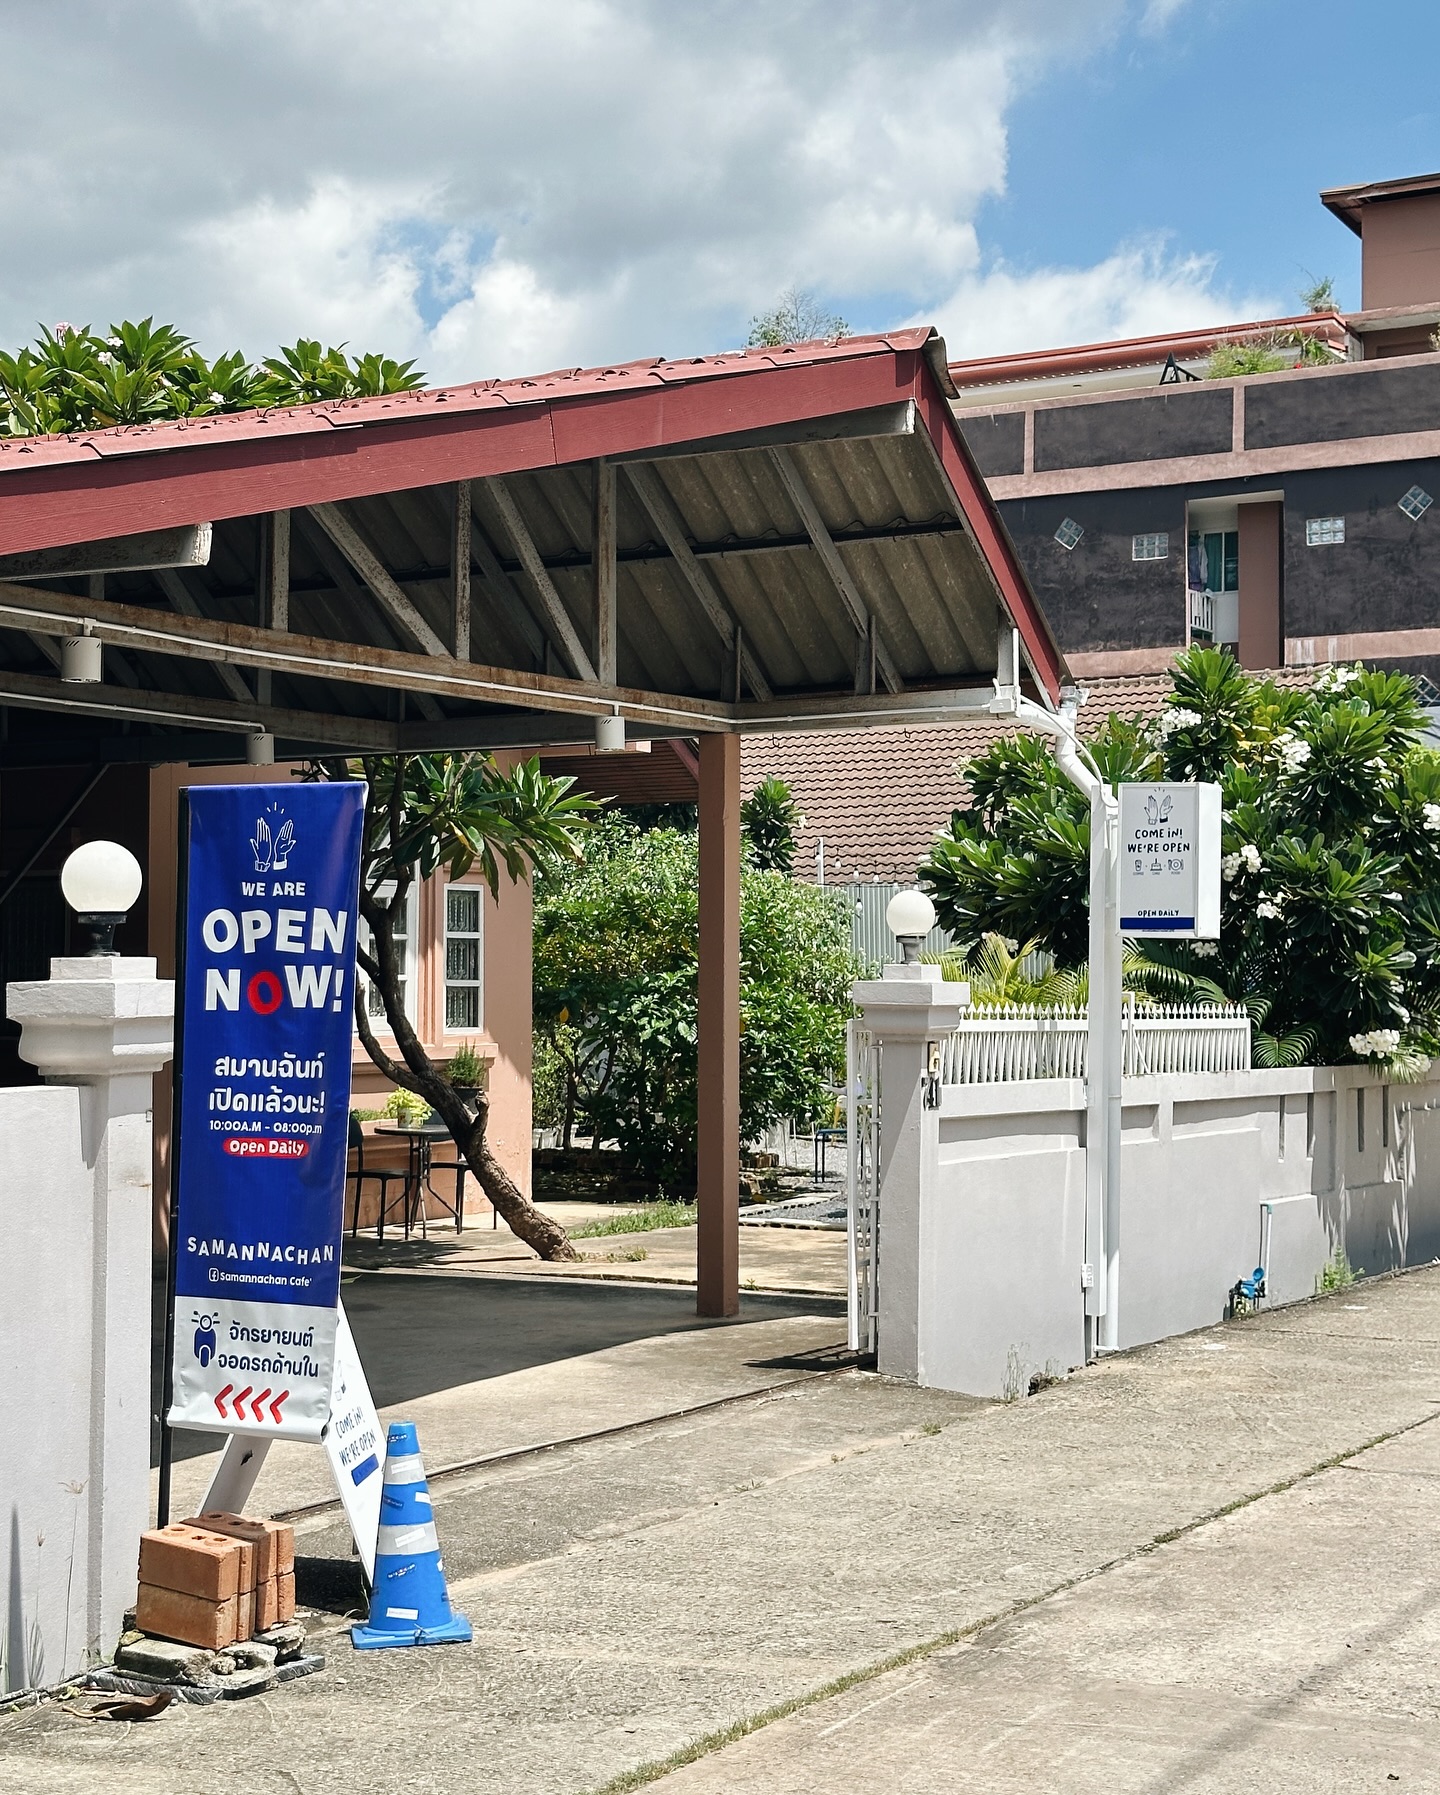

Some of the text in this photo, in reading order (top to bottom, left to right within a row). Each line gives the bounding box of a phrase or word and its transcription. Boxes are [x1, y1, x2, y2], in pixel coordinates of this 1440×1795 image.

[1134, 829, 1164, 839] COME
[1127, 842, 1190, 854] WE'RE OPEN
[241, 881, 306, 897] WE ARE
[1137, 910, 1157, 918] OPEN
[202, 907, 348, 954] OPEN
[205, 965, 345, 1016] NOW!
[214, 1051, 326, 1079] สมานฉันท์
[209, 1085, 326, 1114] เปิดแล้วนะ!
[209, 1120, 262, 1132] 10:00A.M
[229, 1140, 305, 1156] Open Daily
[187, 1236, 334, 1265] SAMANNACHAN
[220, 1271, 288, 1286] Samannachan
[229, 1319, 315, 1348] จักรยายนต์
[217, 1351, 319, 1378] จอดรถด้านใน
[335, 1412, 355, 1439] COME
[338, 1428, 377, 1467] WE'RE OPEN
